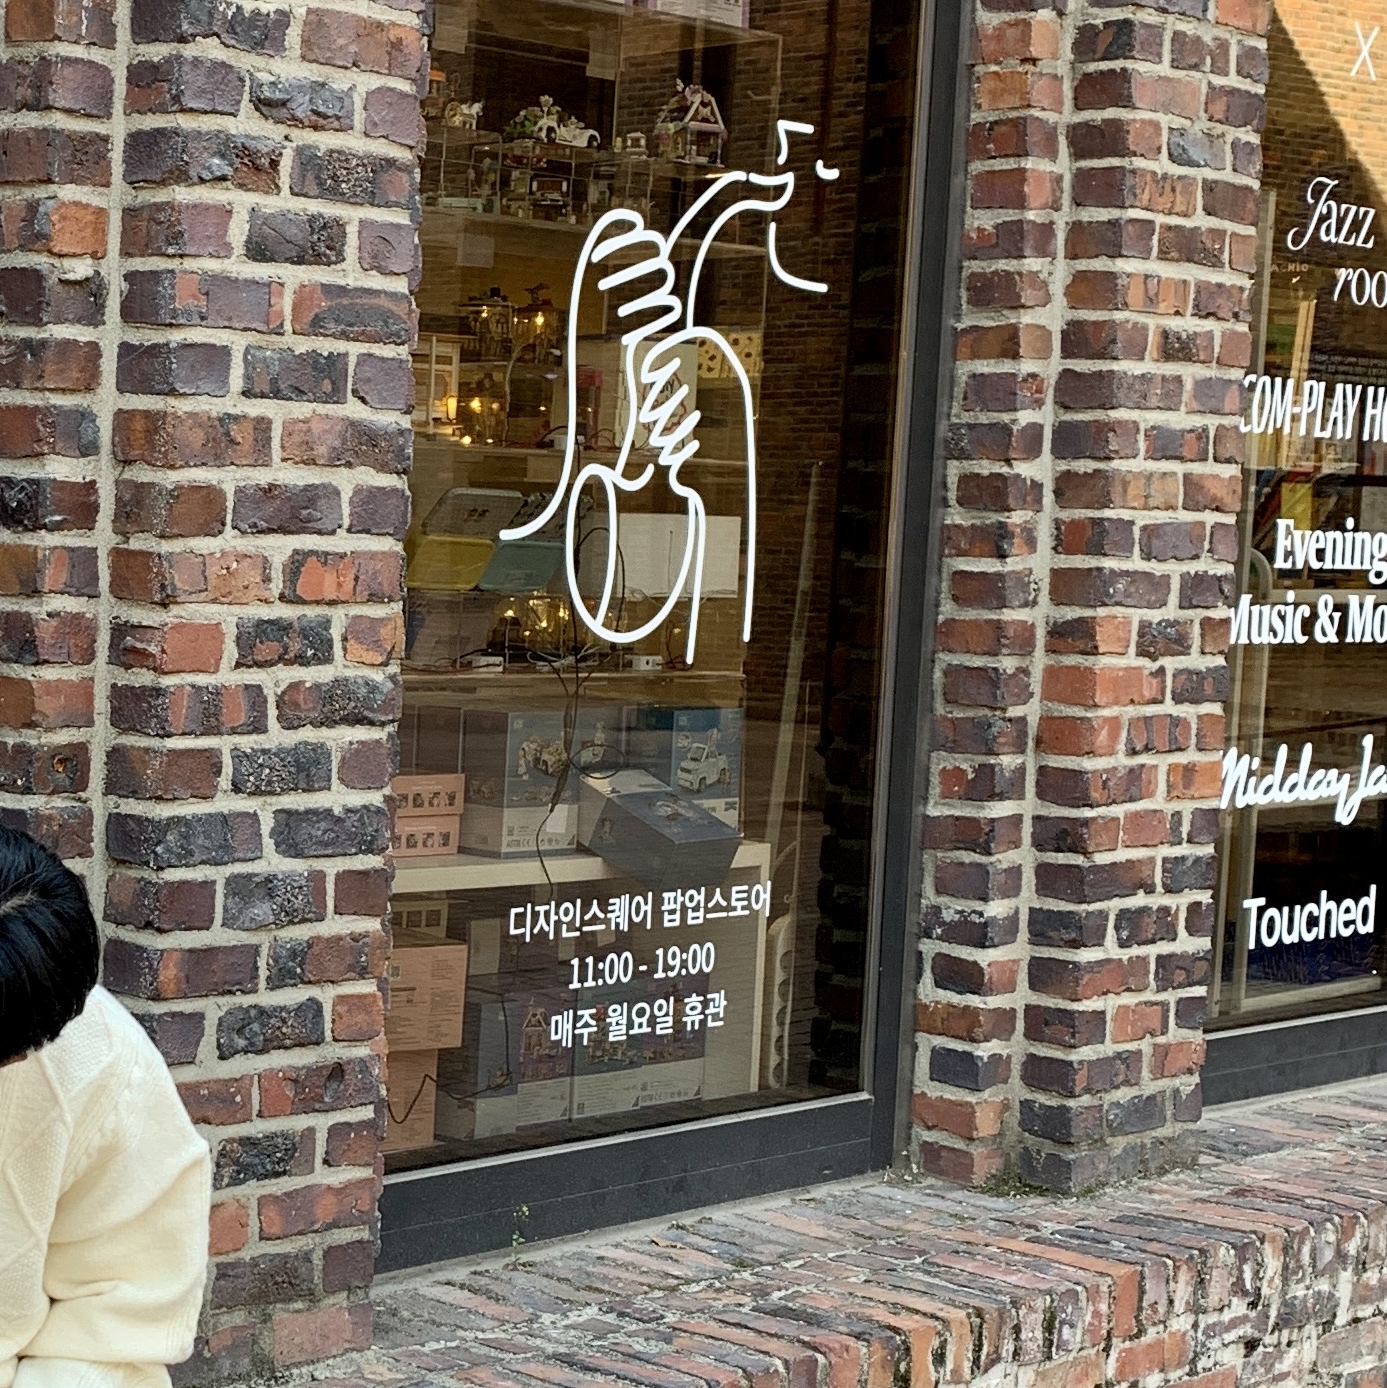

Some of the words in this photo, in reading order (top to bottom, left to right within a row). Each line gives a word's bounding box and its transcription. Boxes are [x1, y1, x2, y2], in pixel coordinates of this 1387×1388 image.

[1287, 176, 1376, 251] Jazz
[1362, 385, 1387, 443] H
[1273, 516, 1387, 585] Evening
[1229, 590, 1311, 645] Music
[1314, 593, 1342, 645] &
[509, 891, 653, 943] 디자인스퀘어
[661, 880, 772, 928] 팝업스토어
[1242, 884, 1377, 950] Touched
[568, 951, 634, 990] 11:00
[653, 941, 715, 979] 19:00
[550, 1008, 598, 1048] 매주
[605, 996, 674, 1042] 월요일
[682, 989, 728, 1031] 휴관
